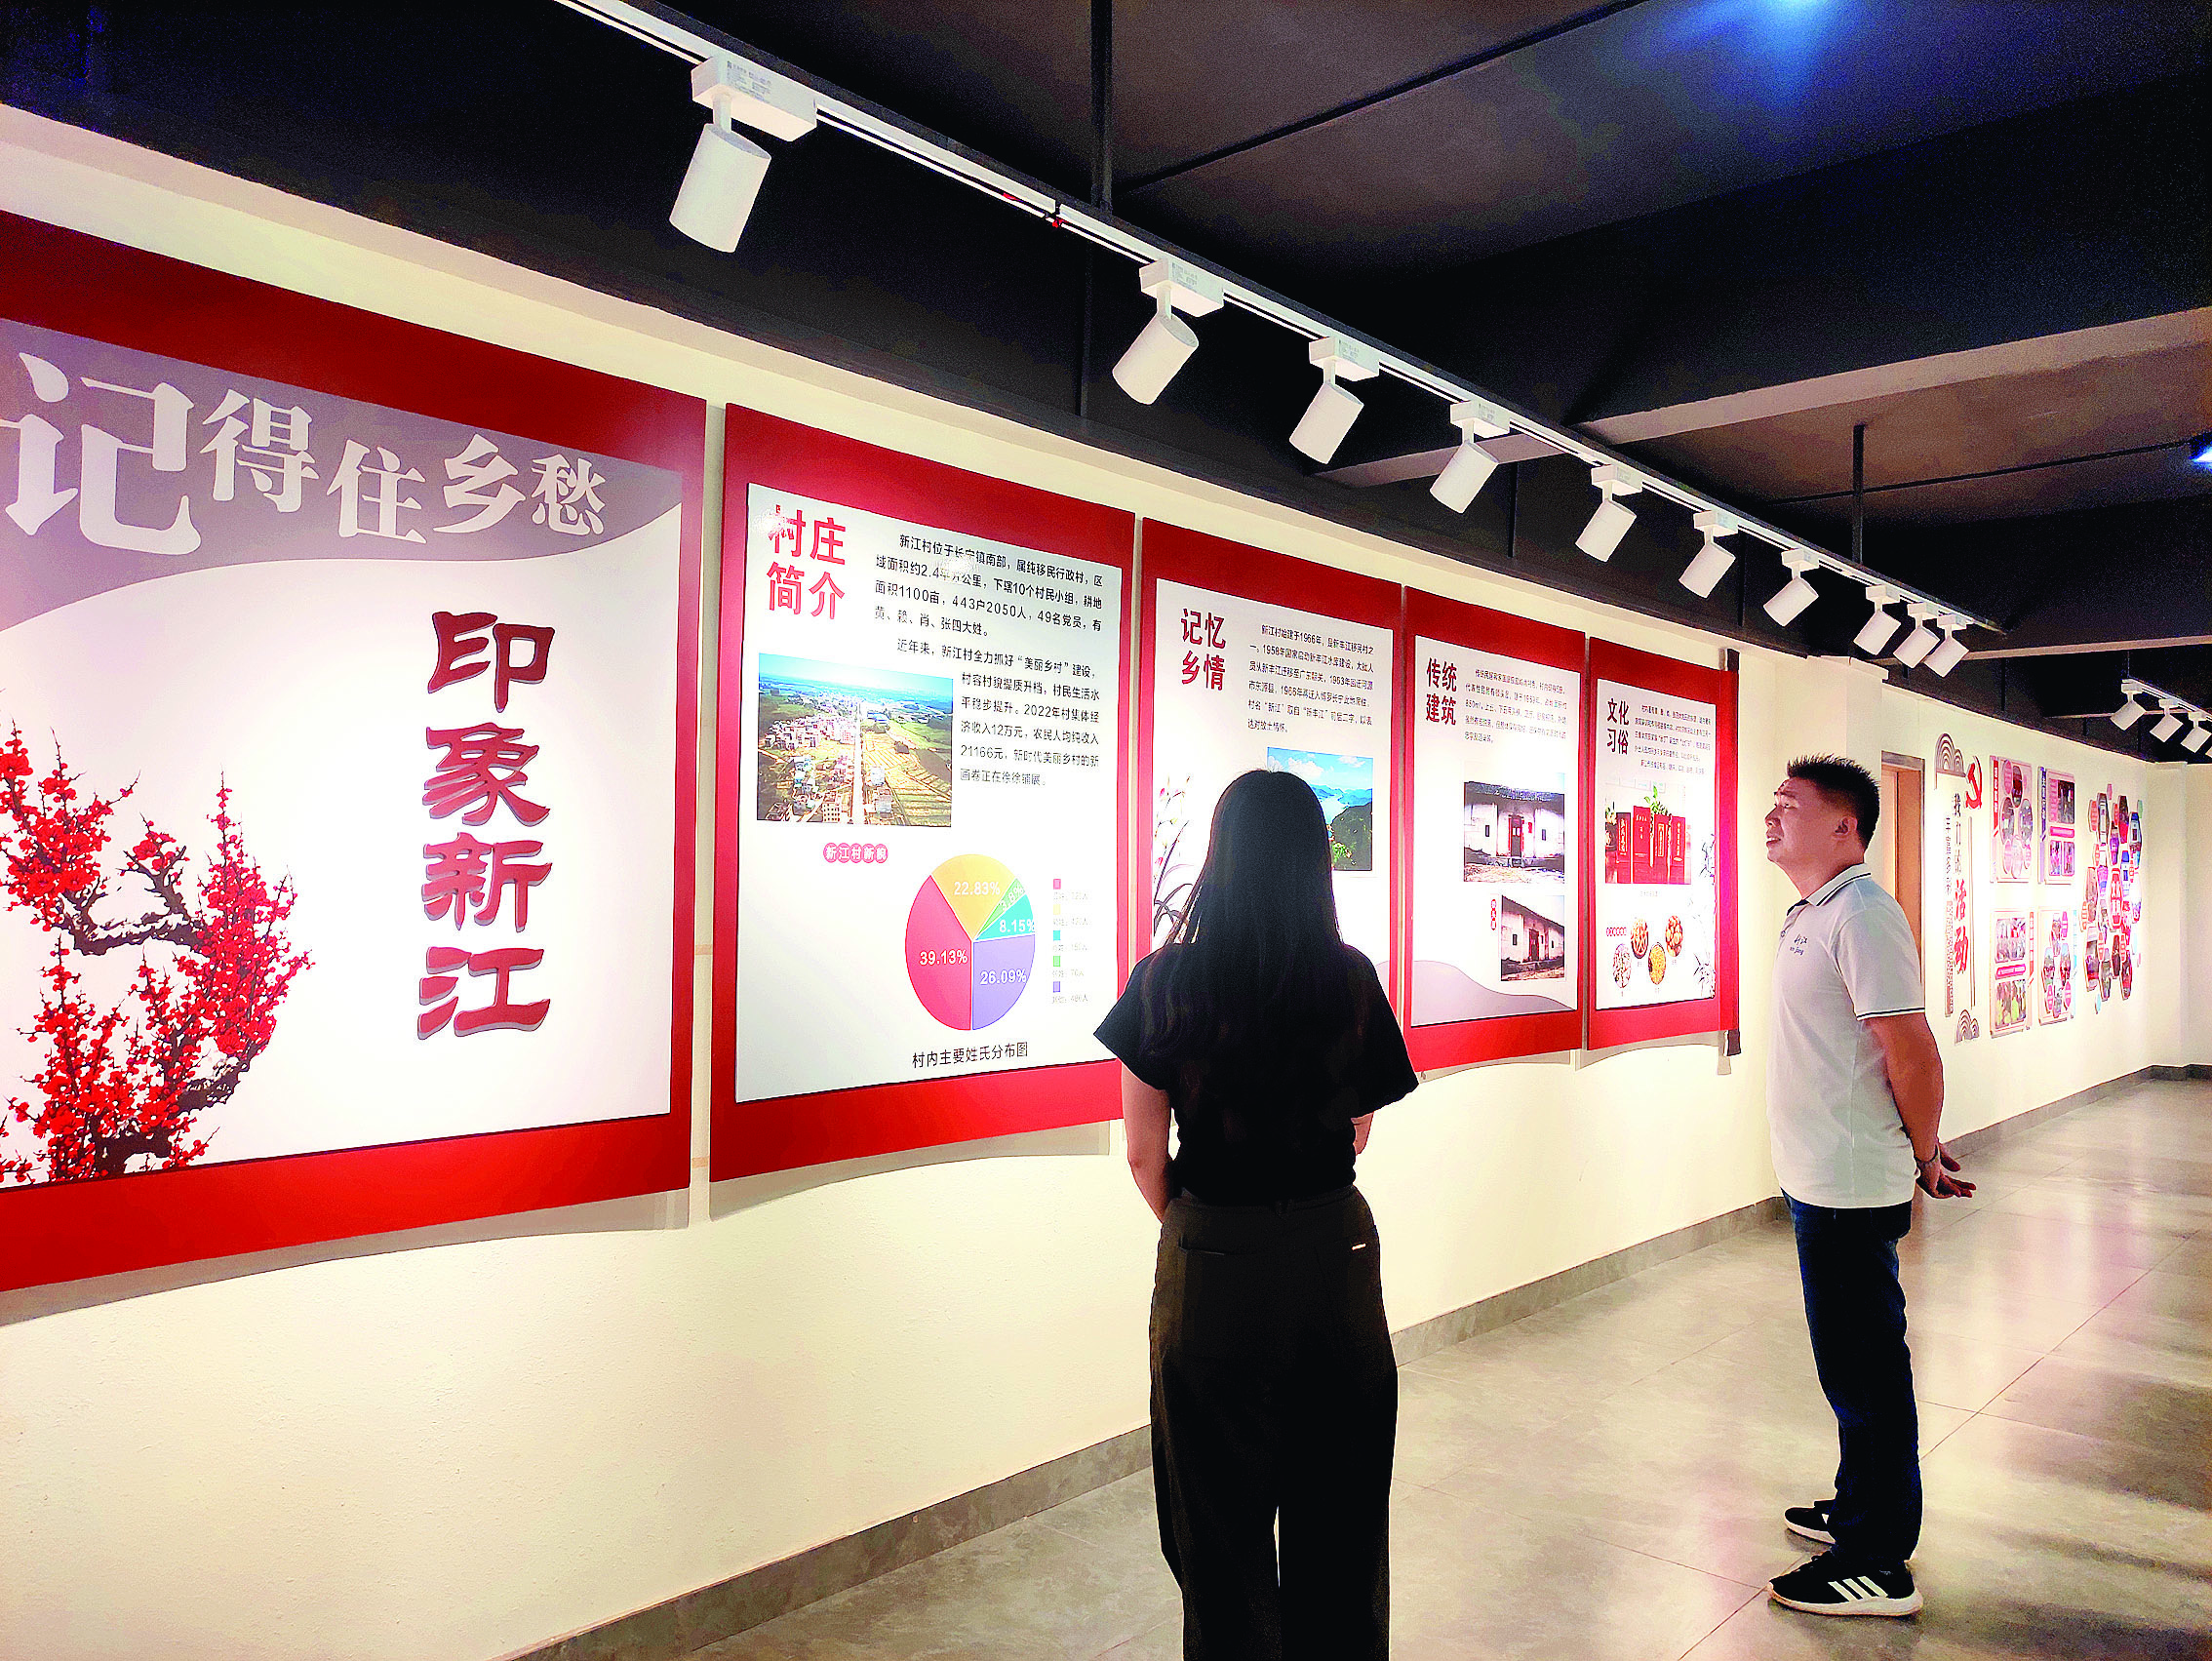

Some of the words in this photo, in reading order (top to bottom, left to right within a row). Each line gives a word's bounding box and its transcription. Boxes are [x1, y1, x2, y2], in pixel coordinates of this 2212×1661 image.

[0, 352, 606, 555] 记得住乡愁
[766, 504, 847, 565] 村庄
[766, 561, 846, 620] 简介
[1180, 608, 1227, 649] 记忆
[1181, 650, 1226, 692] 乡情
[1426, 656, 1457, 692] 传统
[1425, 692, 1457, 726] 建筑
[1606, 697, 1630, 726] 文化
[1606, 728, 1629, 755] 习俗
[417, 612, 556, 1041] 印象新江
[824, 845, 888, 862] 新江村新貌
[954, 881, 1001, 896] 22.83%
[1001, 883, 1025, 912] 3.8%
[999, 919, 1035, 933] 8.15%
[919, 948, 968, 966] 39.13%
[979, 969, 1028, 985] 26.09%
[912, 1041, 1029, 1069] 村内主要姓氏分布图
